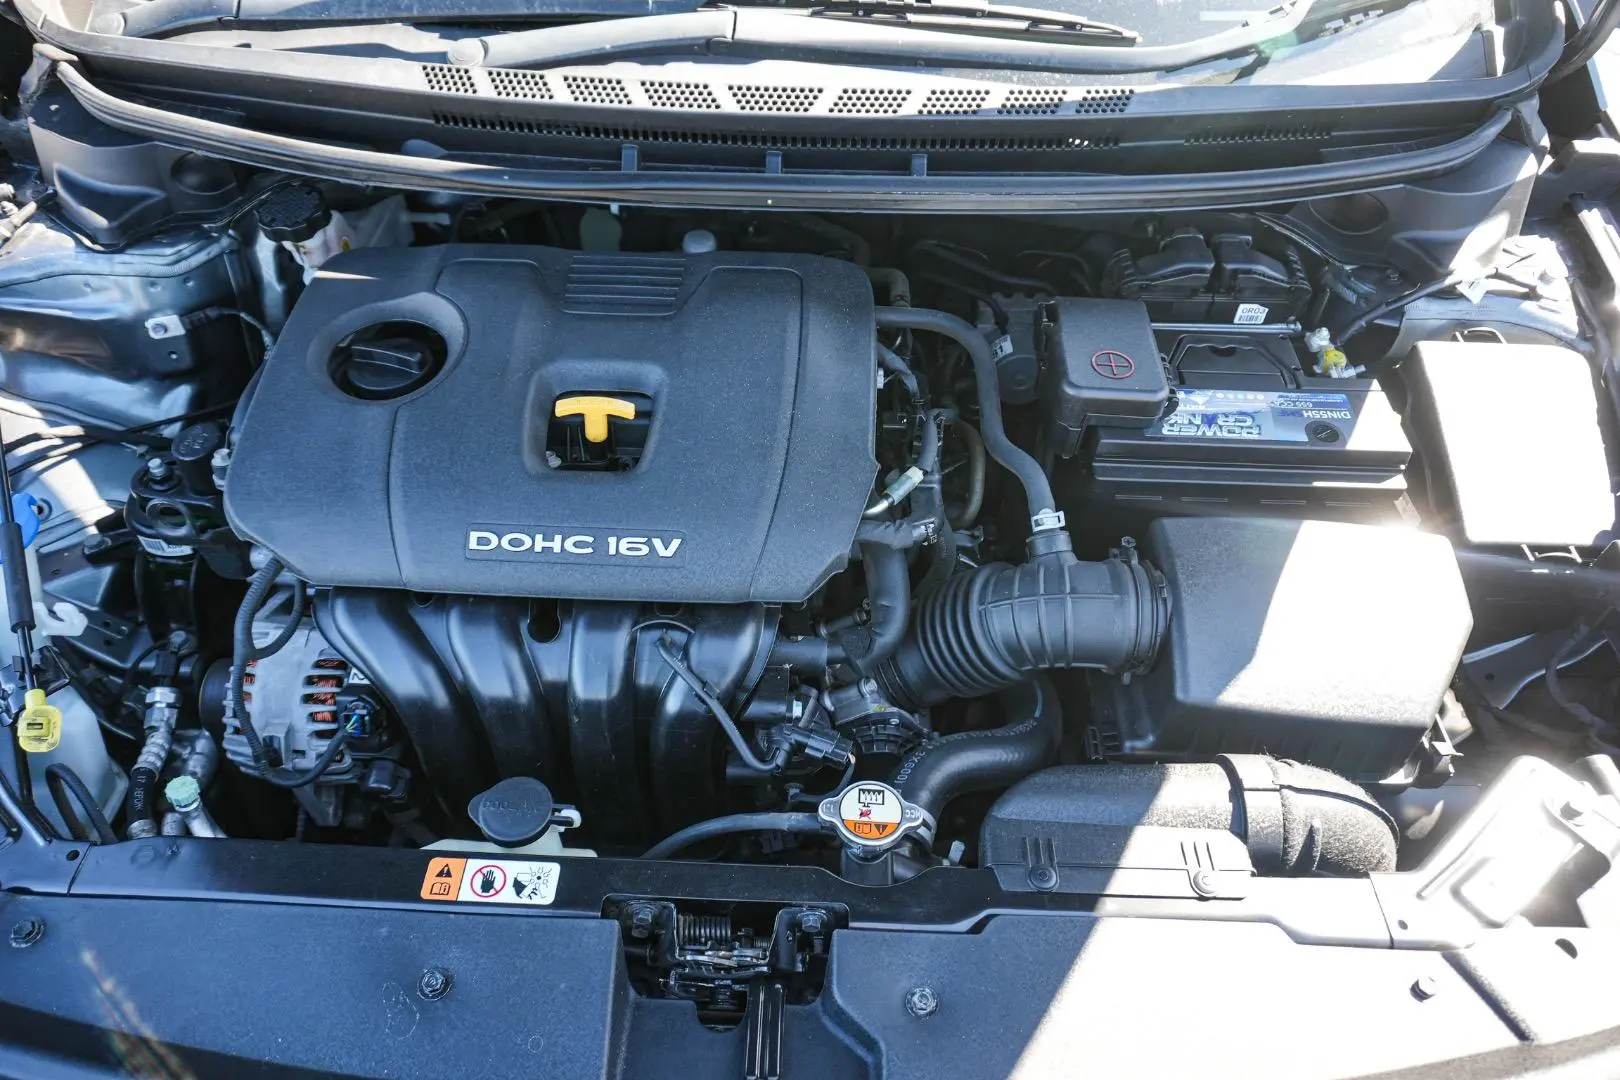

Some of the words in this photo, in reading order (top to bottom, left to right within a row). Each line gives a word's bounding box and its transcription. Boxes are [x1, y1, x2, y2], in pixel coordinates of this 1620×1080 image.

[1168, 413, 1254, 425] CRANK
[1161, 424, 1261, 437] POWER
[468, 531, 595, 554] DOHC
[607, 536, 683, 557] 16V
